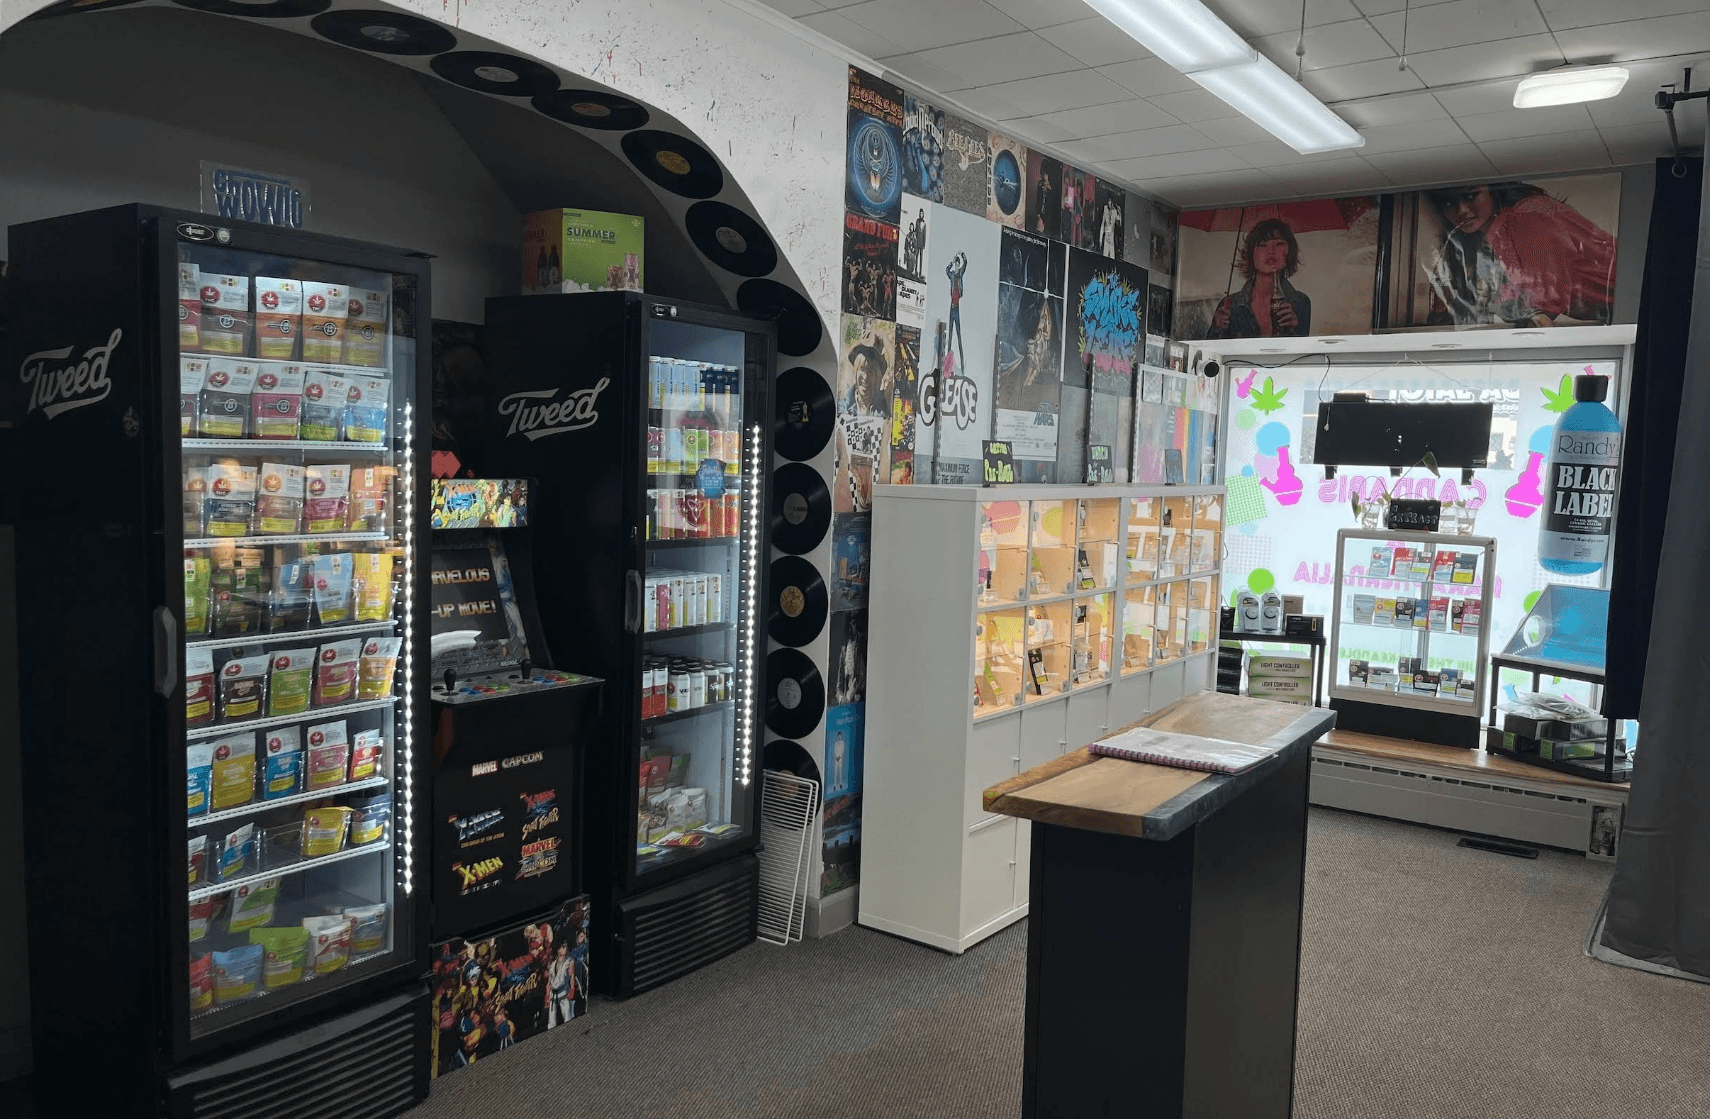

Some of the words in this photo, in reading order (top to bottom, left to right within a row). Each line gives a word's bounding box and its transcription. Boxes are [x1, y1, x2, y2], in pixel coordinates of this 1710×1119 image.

[566, 227, 616, 241] SUMMER
[20, 328, 122, 420] Tweed
[498, 377, 611, 442] Tweed
[919, 374, 977, 431] GEASE
[1557, 465, 1617, 491] BLACK
[1554, 491, 1614, 518] LABEL
[431, 568, 491, 585] RVELOUS
[458, 600, 497, 617] MOVE!
[472, 760, 498, 777] MARVEL
[502, 751, 543, 768] CAPCOM
[539, 807, 559, 831] FIGHTER
[522, 837, 555, 857] MARVEL
[460, 857, 503, 889] X-MEN
[521, 855, 557, 873] CAPCOM
[514, 973, 538, 1000] FIGHTER
